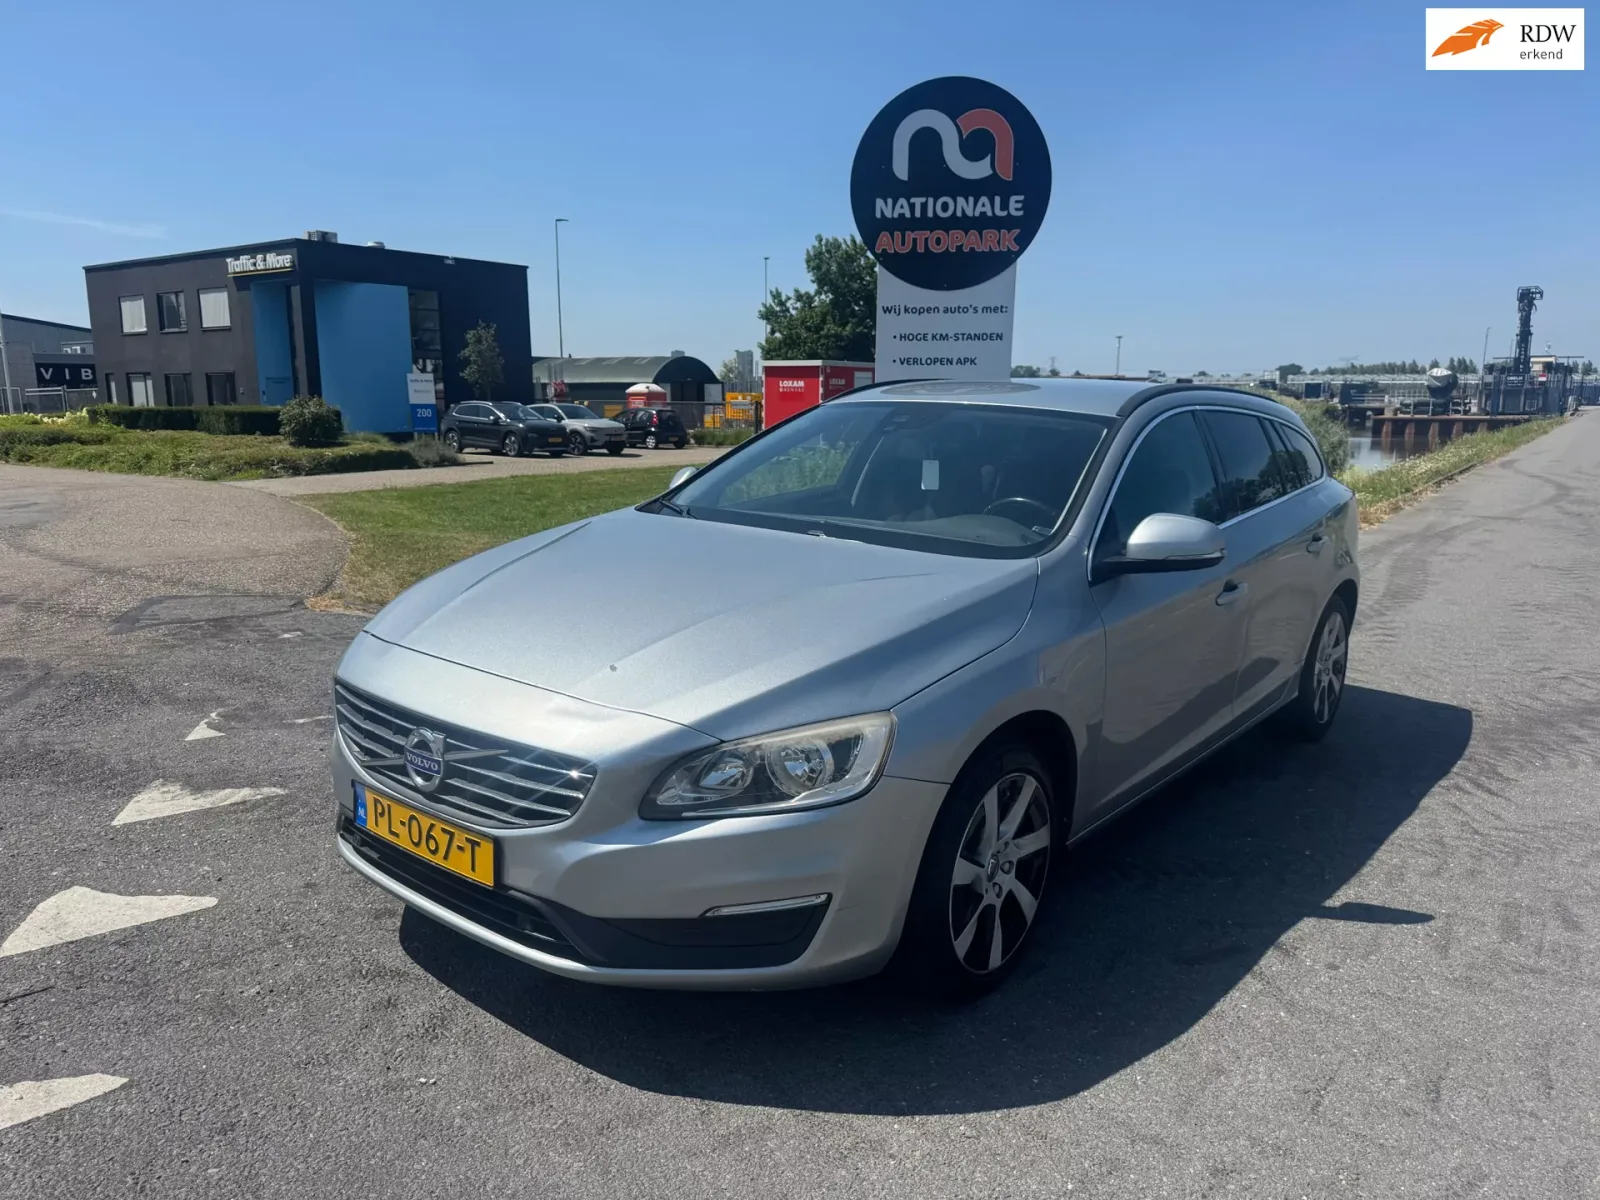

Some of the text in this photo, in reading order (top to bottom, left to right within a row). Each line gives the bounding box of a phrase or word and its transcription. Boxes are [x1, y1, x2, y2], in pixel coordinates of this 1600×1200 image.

[875, 195, 1025, 219] NATIONALE
[875, 229, 1021, 254] AUTOPARK
[225, 252, 293, 273] Traffic & More
[881, 304, 1009, 316] Wij kopen auto's met:
[899, 332, 1004, 342] HOGE KM-STANDEN
[898, 356, 978, 366] VERLOPEN APK
[416, 408, 432, 418] 200
[405, 751, 439, 771] VOLVO
[358, 806, 367, 819] NL
[372, 796, 482, 873] PL-067-T
